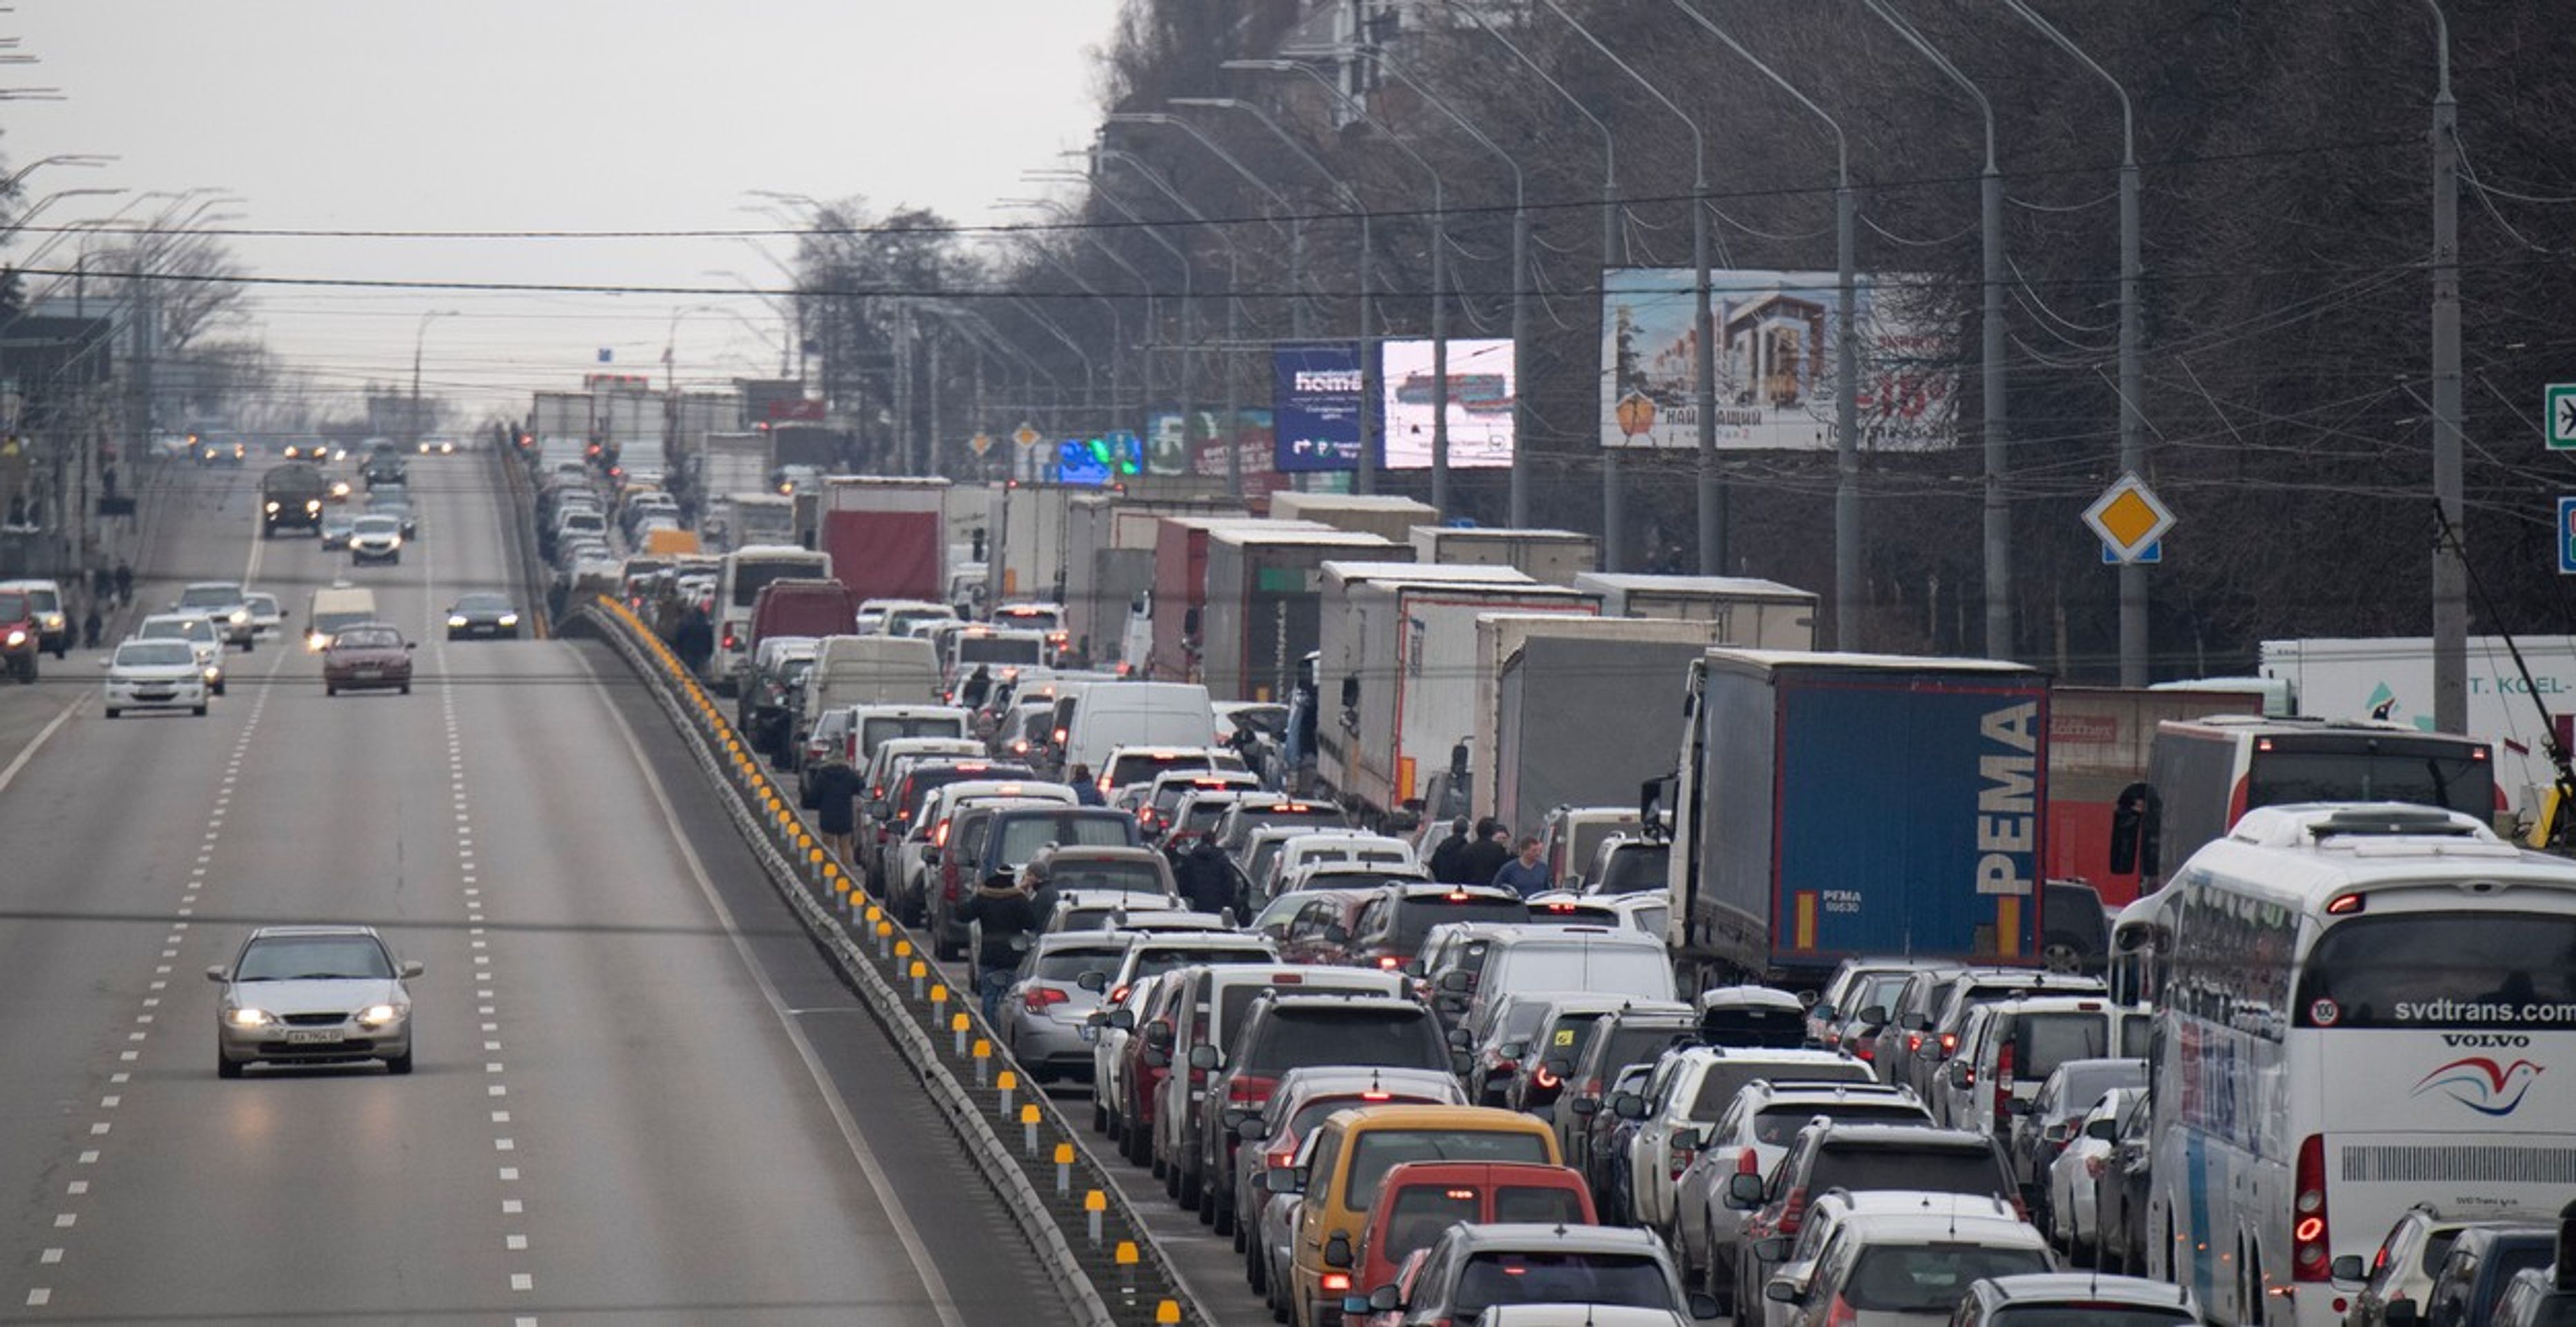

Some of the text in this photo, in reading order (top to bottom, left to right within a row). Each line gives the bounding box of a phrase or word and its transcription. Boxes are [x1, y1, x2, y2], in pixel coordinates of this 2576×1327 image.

[1666, 409, 1761, 428] НАЙАЩИЙ
[2469, 677, 2490, 693] T.
[1976, 700, 2038, 895] PEMA
[1823, 890, 1861, 901] PEMA
[2394, 997, 2576, 1022] svdtrans.com
[2441, 1034, 2530, 1048] VOLVO
